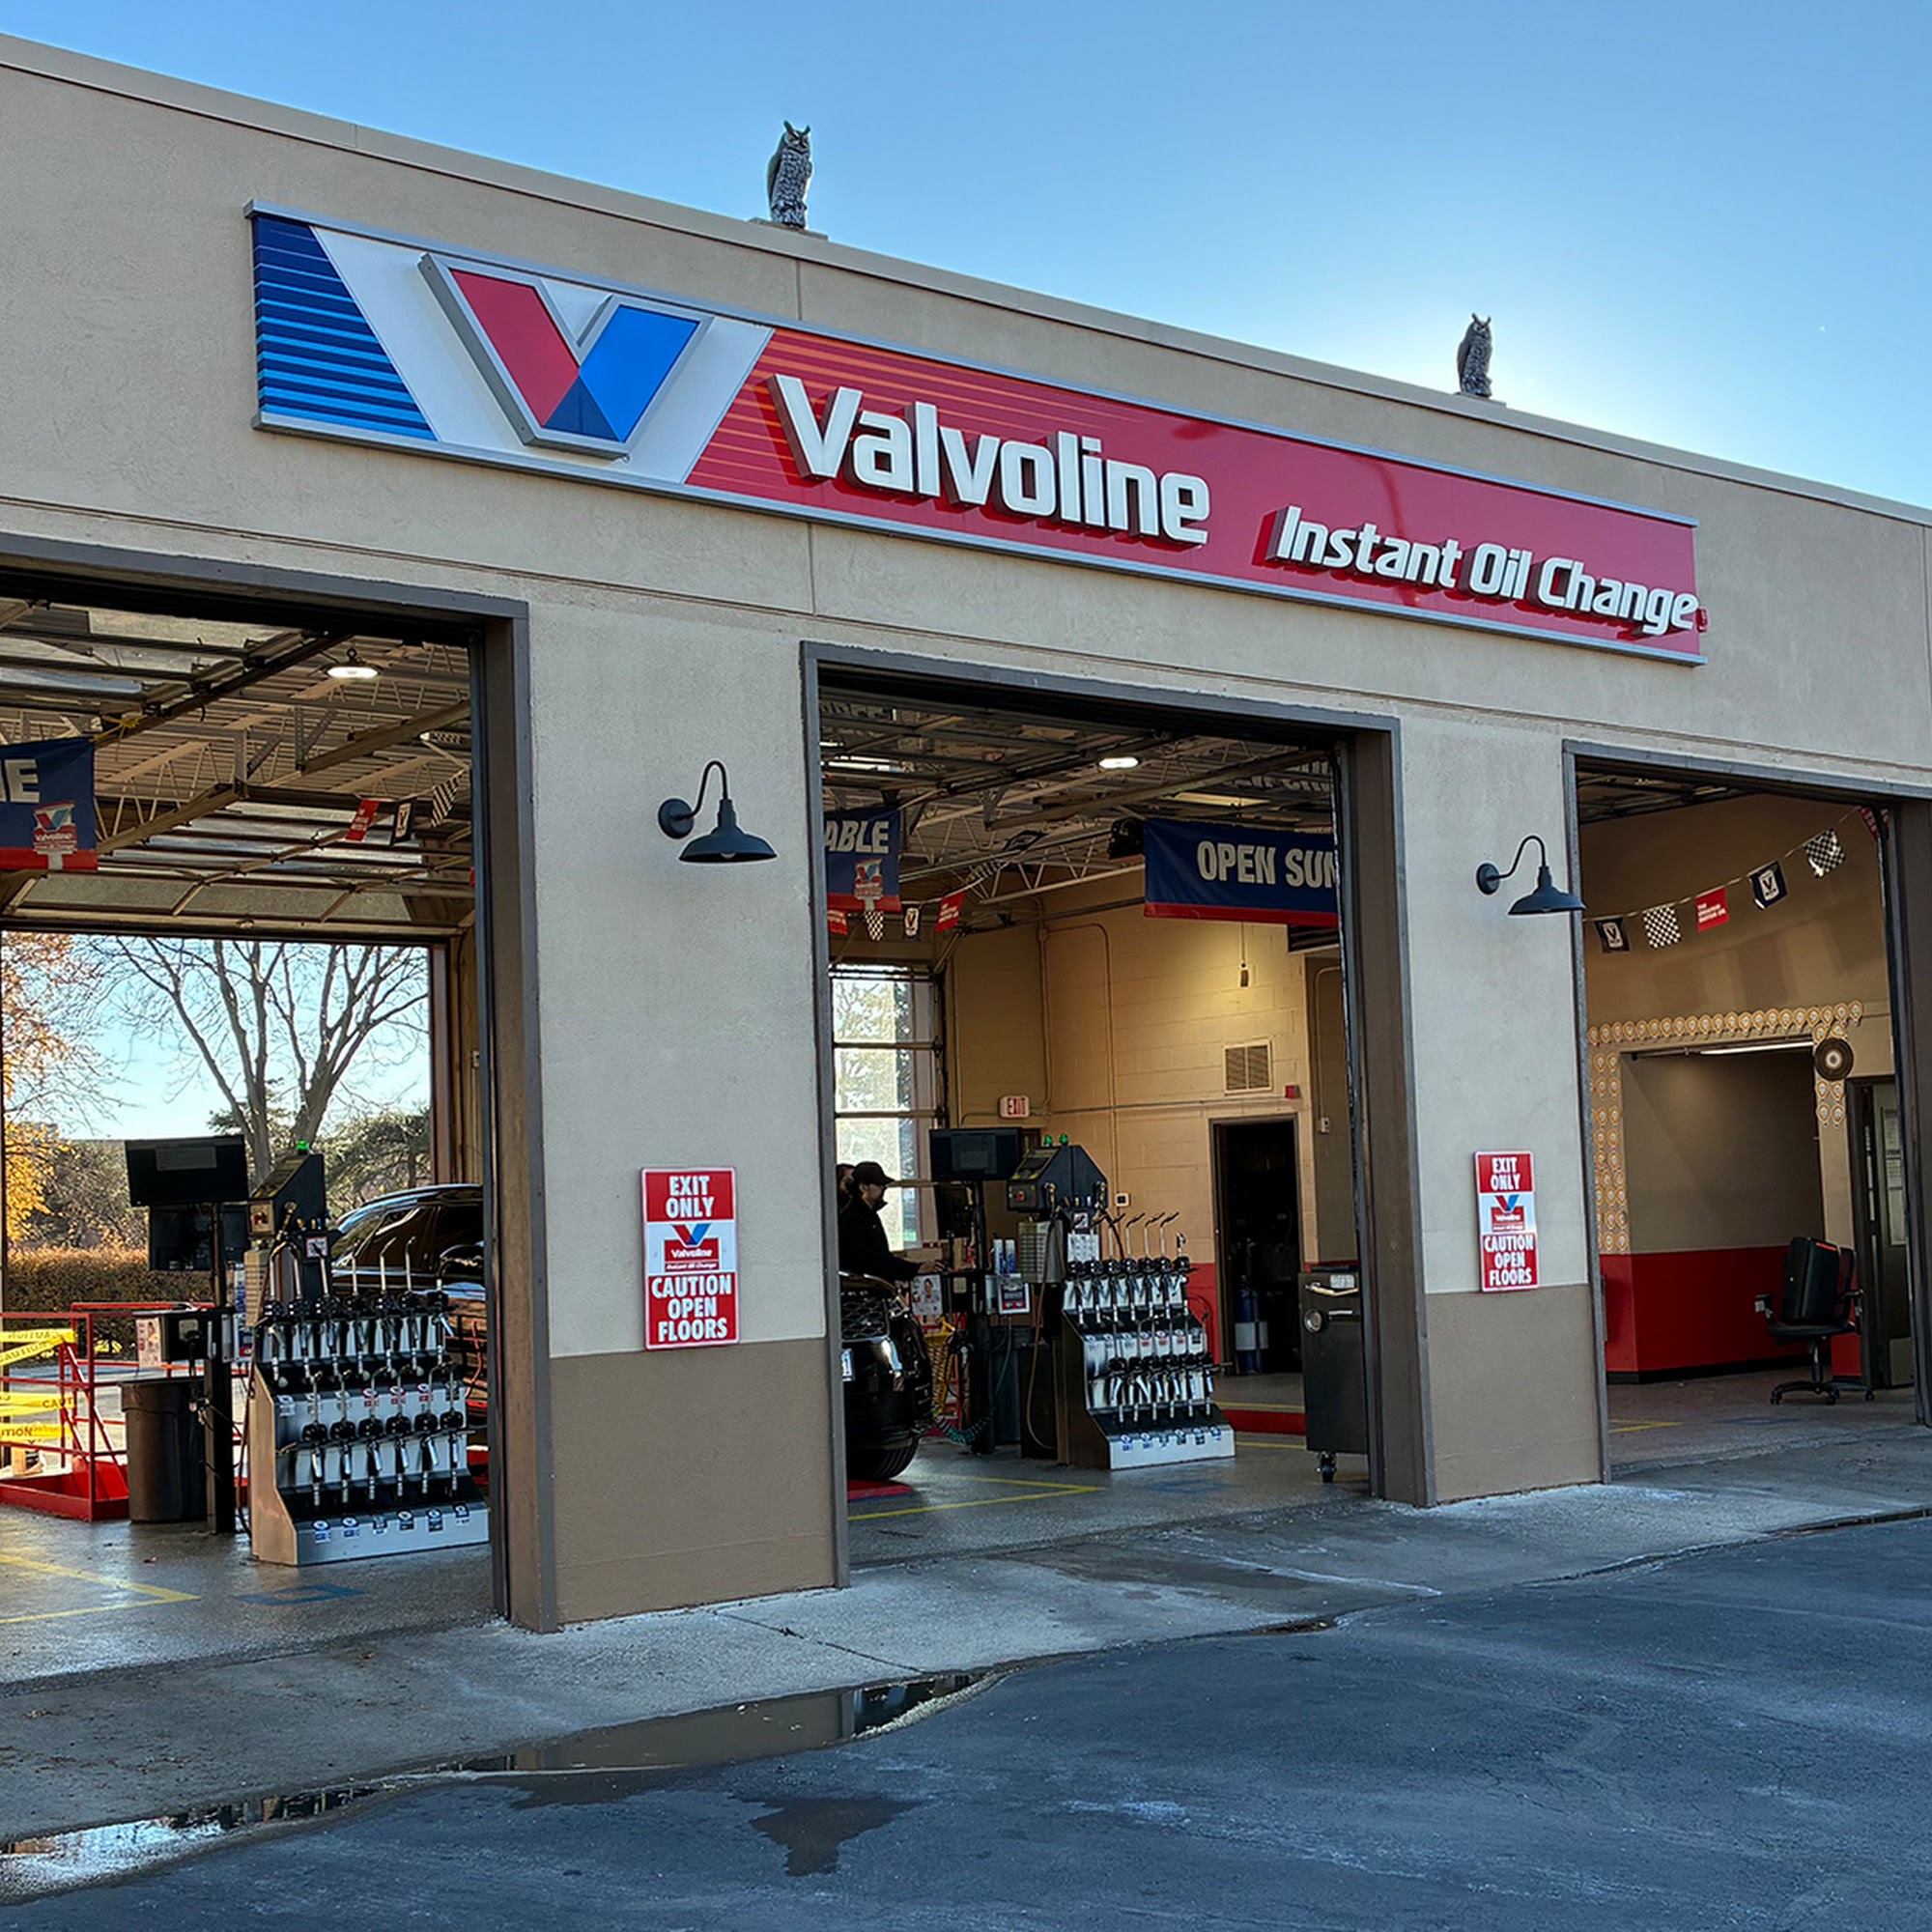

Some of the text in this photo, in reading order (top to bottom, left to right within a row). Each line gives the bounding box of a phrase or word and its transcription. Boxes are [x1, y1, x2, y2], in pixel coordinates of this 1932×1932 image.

[775, 374, 1210, 545] Valvoline
[1277, 505, 1699, 636] Instant Oil Change
[1197, 839, 1276, 885] OPEN
[1008, 1097, 1026, 1115] EXIT
[1492, 1156, 1518, 1173] EXIT
[668, 1176, 710, 1196] EXIT
[1491, 1174, 1520, 1190] ONLY
[666, 1197, 715, 1218] ONLY
[1484, 1235, 1534, 1252] CAUTION
[1494, 1252, 1525, 1269] OPEN
[651, 1274, 732, 1298] CAUTION
[1490, 1268, 1532, 1287] FLOORS
[668, 1296, 717, 1320] OPEN
[658, 1318, 728, 1343] FLOORS
